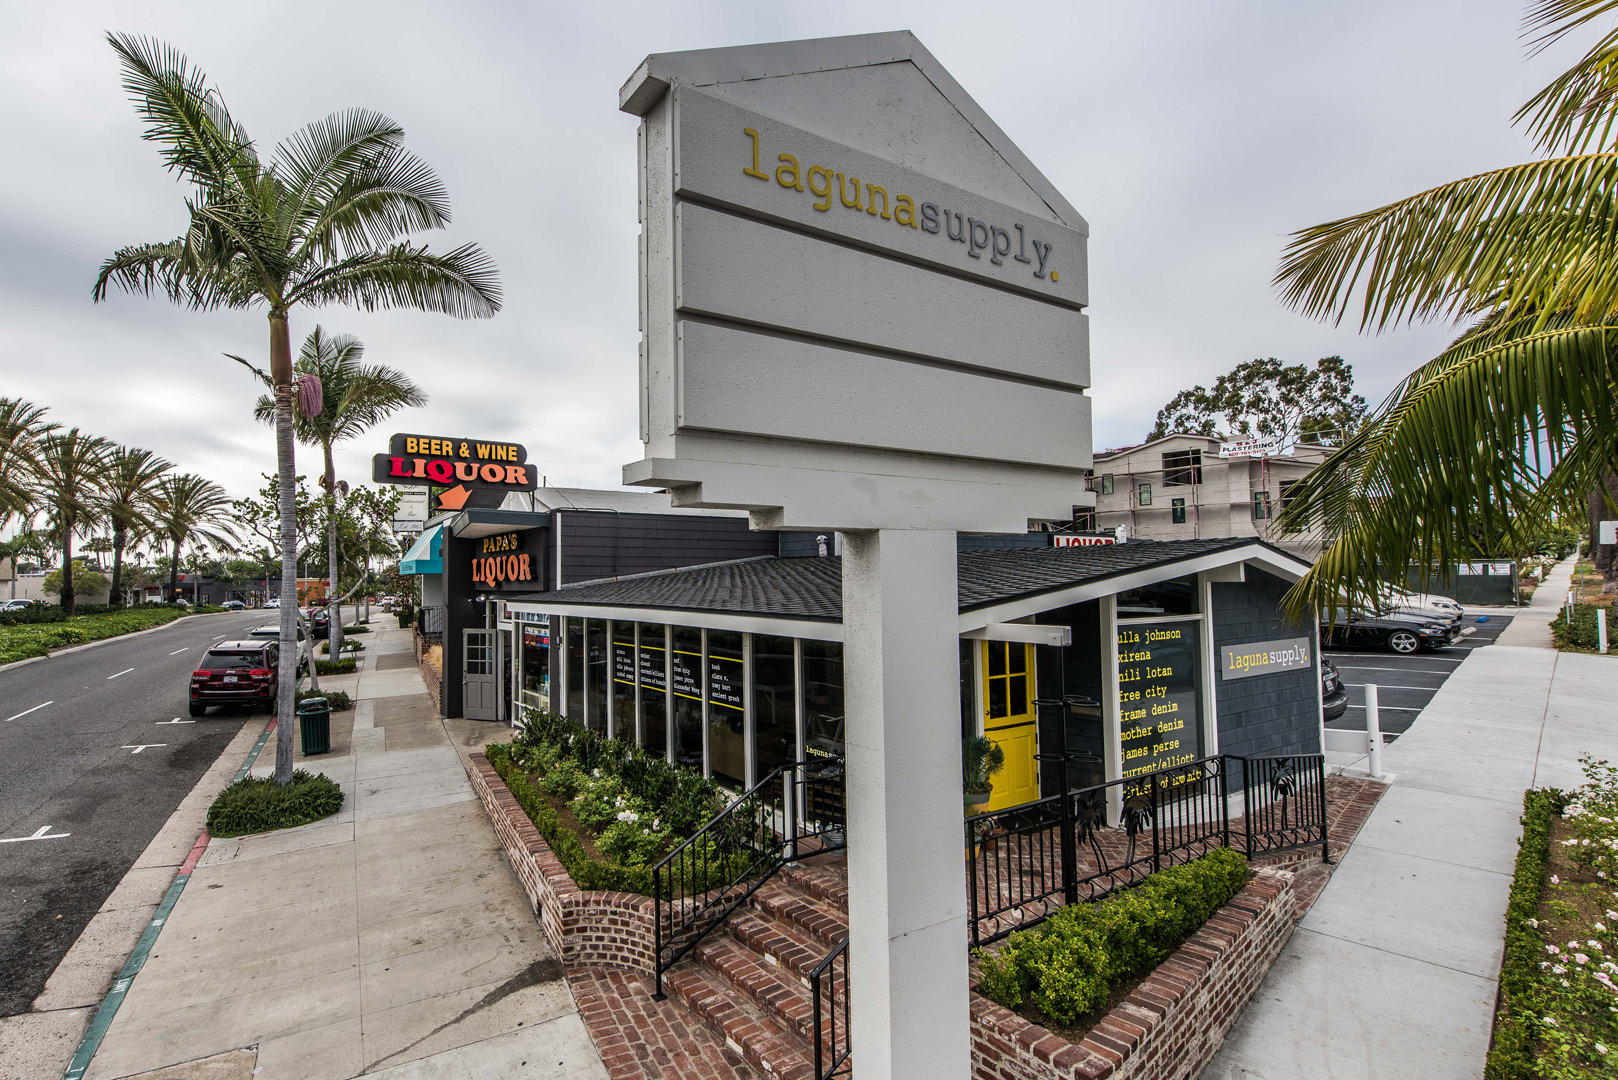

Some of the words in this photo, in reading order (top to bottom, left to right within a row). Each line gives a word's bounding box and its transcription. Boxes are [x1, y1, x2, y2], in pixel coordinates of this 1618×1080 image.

[743, 127, 1059, 282] lagunasupply.
[406, 437, 453, 456] BEER
[459, 442, 470, 458] &
[476, 443, 518, 462] WINE
[1222, 441, 1274, 452] PLASTERING
[389, 456, 529, 484] LIQUOR
[483, 533, 518, 553] PAPA'S
[472, 553, 531, 588] LIQUOR
[1117, 631, 1140, 644] ulla
[1145, 629, 1181, 644] johnson
[1118, 650, 1151, 663] xirena
[1229, 645, 1308, 672] lagunasupply.
[1119, 668, 1141, 682] nili
[1146, 667, 1173, 679] lotan
[1119, 690, 1141, 702] free
[1145, 685, 1167, 698] city
[1120, 708, 1147, 721] frame
[1151, 701, 1178, 716] denim
[1121, 726, 1153, 741] mother
[1157, 718, 1184, 733] denim
[1121, 746, 1149, 763] james
[1153, 739, 1180, 756] perse
[1122, 753, 1195, 779] current/elliott
